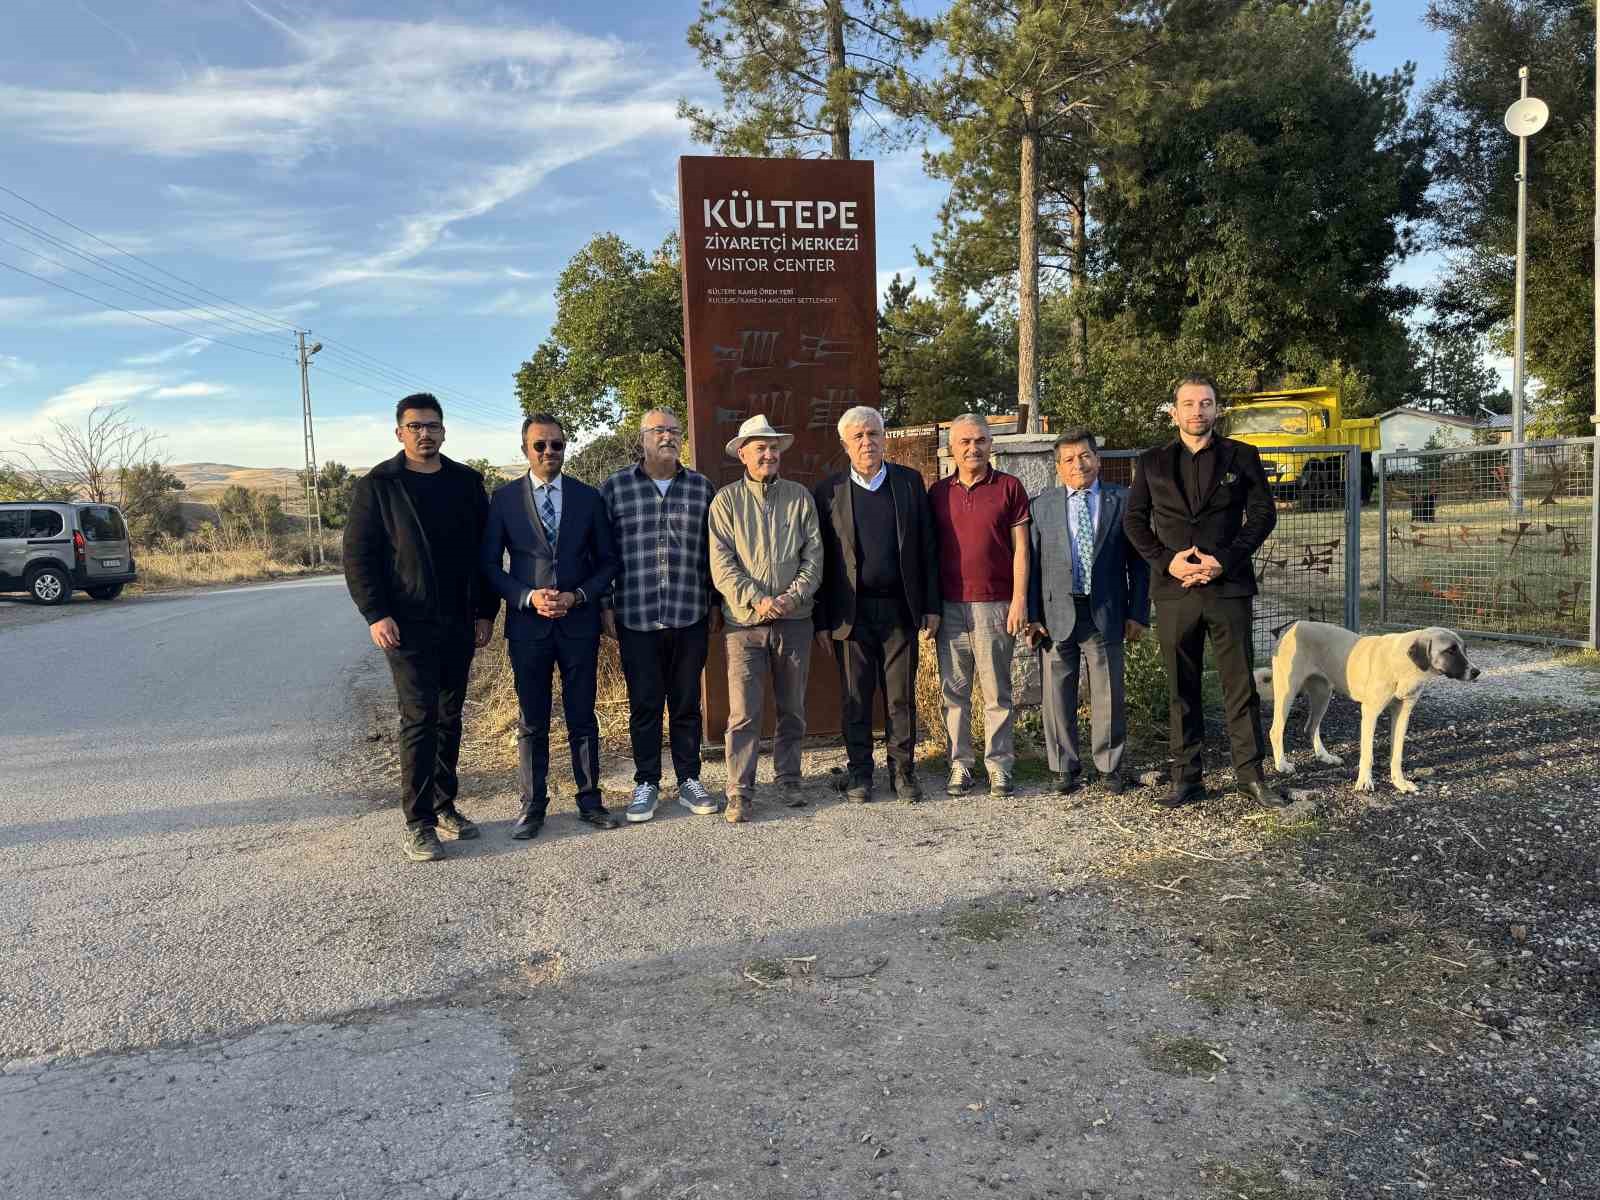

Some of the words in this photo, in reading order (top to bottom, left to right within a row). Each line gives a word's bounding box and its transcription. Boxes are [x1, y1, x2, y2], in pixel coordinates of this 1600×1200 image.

[703, 190, 858, 229] KÜLTEPE
[704, 232, 786, 253] ZİYARETÇİ
[791, 233, 859, 251] MERKEZİ
[705, 257, 769, 272] VISITOR
[774, 258, 836, 272] CENTER
[885, 430, 905, 439] LTEPE
